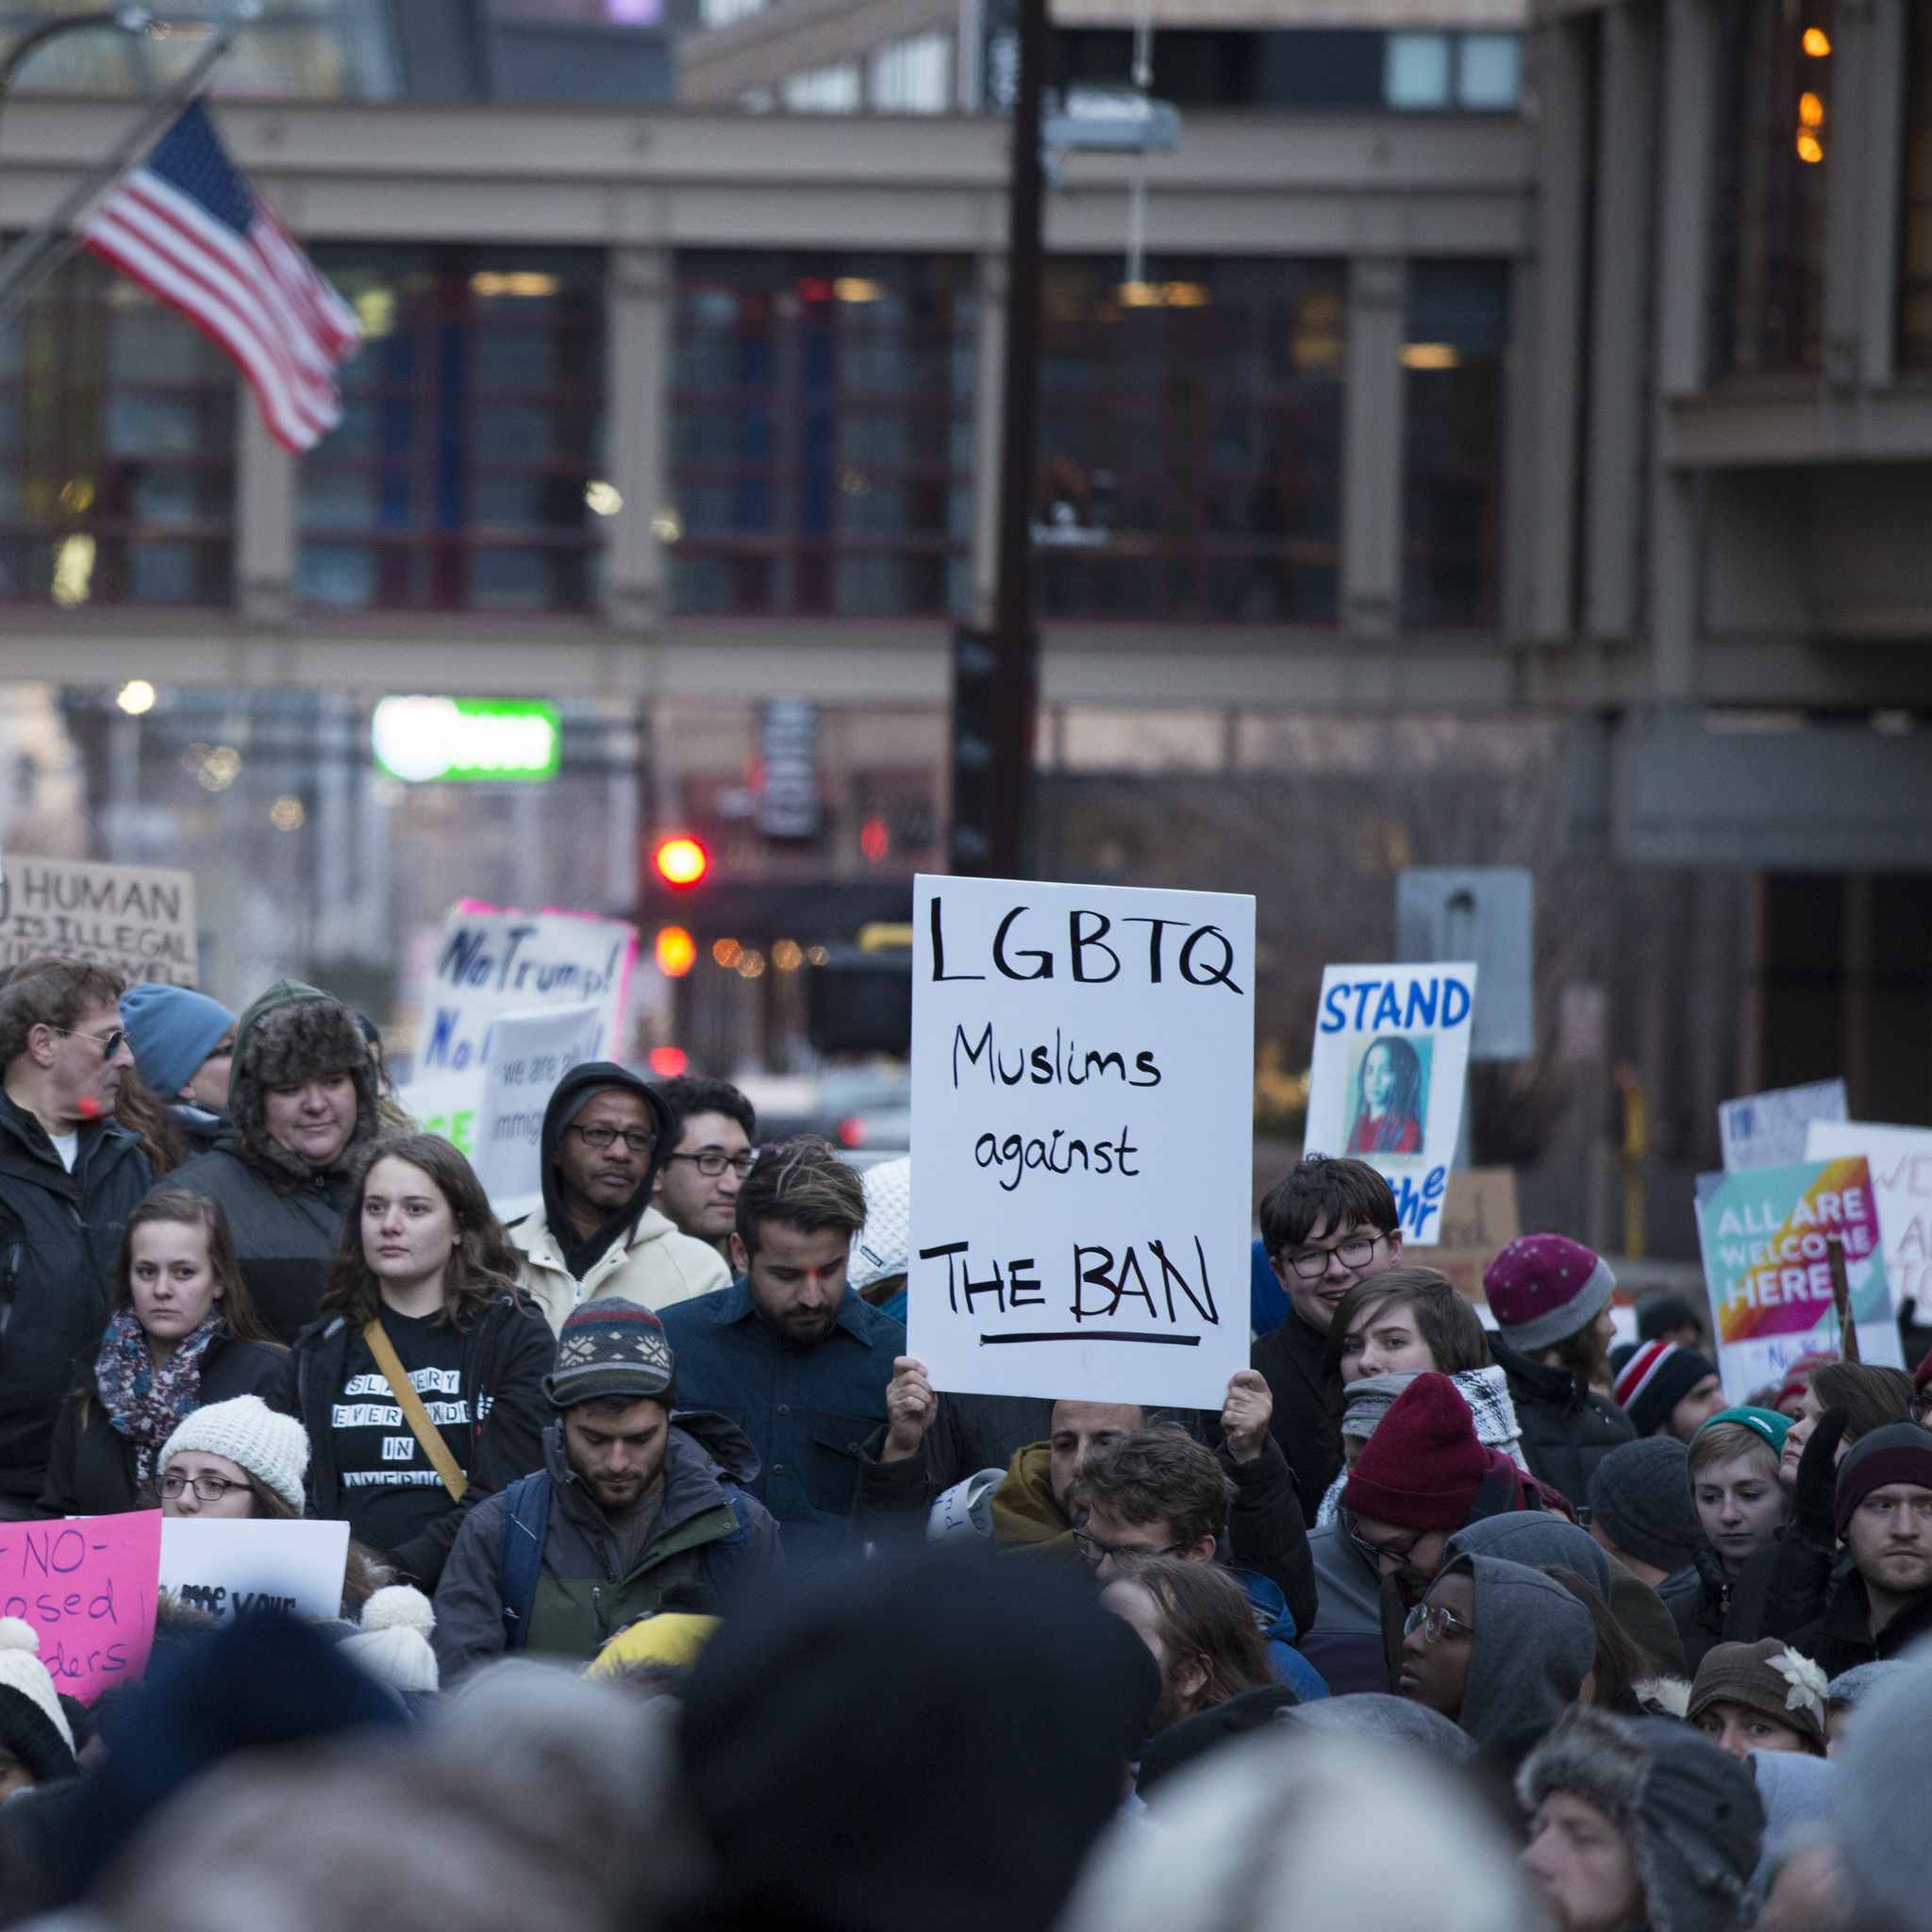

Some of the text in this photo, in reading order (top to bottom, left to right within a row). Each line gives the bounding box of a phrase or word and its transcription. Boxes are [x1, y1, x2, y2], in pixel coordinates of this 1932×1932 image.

[23, 867, 183, 924] HUMAN
[437, 924, 621, 1005] No Trump!
[930, 896, 1244, 995] LGBTQ
[1320, 977, 1472, 1034] STAND
[425, 1006, 472, 1071] No
[952, 1021, 1162, 1090] Muslims
[503, 1058, 525, 1086] we
[529, 1054, 556, 1085] are
[974, 1124, 1141, 1192] against
[1716, 1187, 1868, 1239] ALL ARE
[919, 1235, 1220, 1325] THE BAN
[1724, 1260, 1835, 1312] HERE
[386, 1441, 410, 1456] IN
